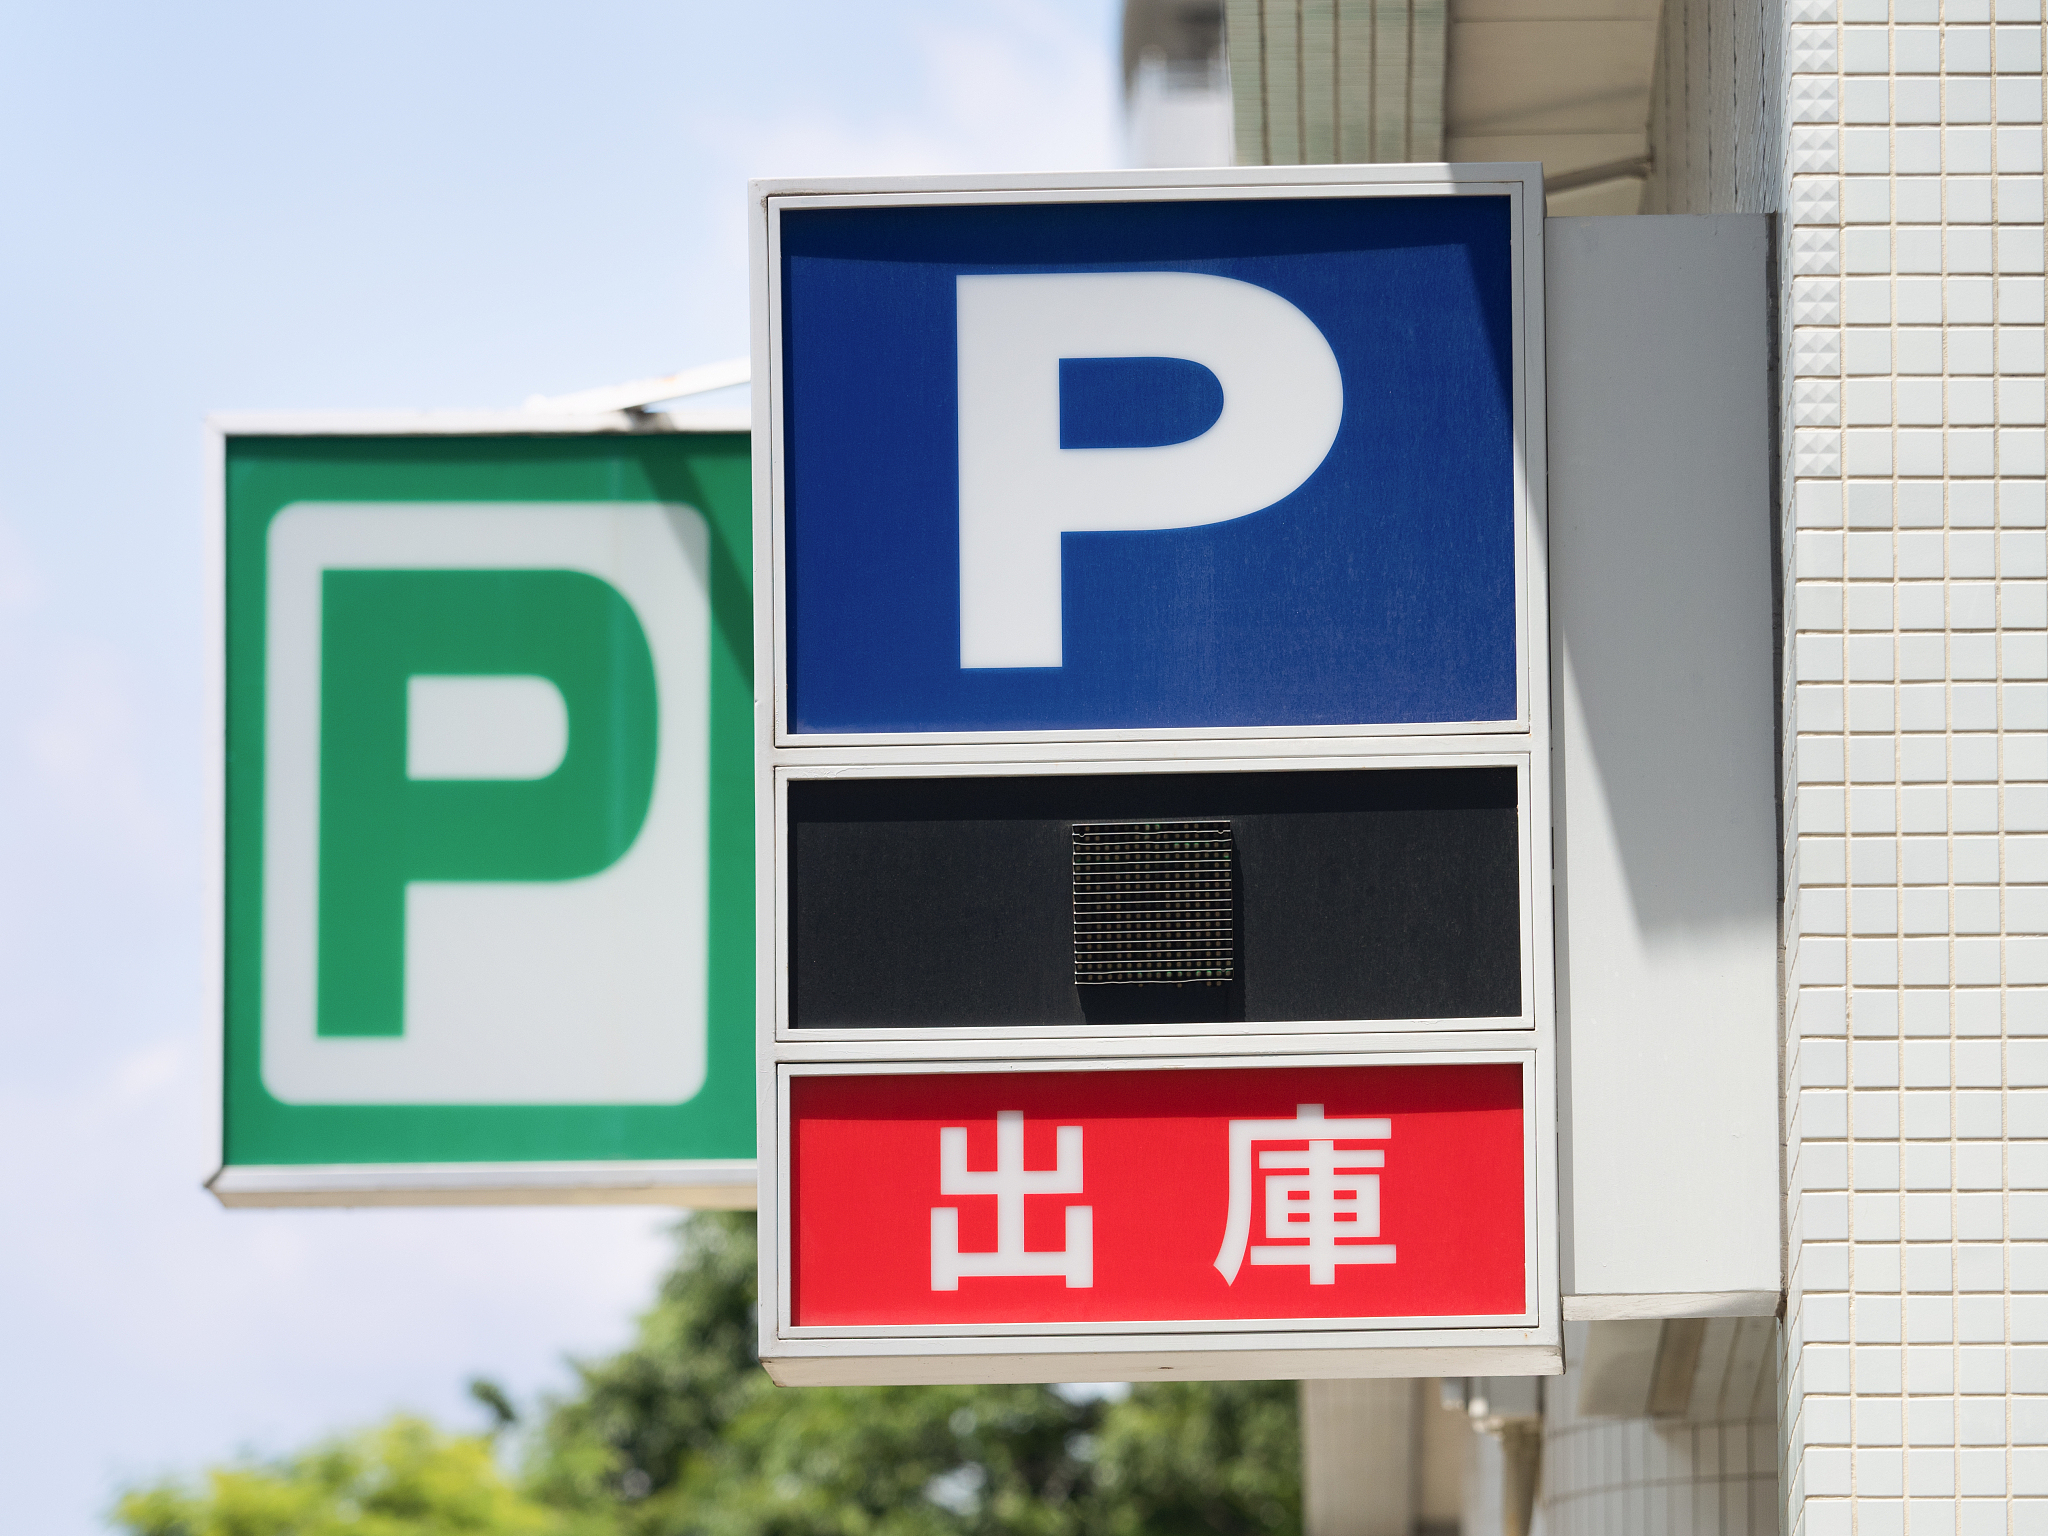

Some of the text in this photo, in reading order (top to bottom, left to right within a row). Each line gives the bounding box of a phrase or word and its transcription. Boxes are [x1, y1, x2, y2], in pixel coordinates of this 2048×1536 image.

[957, 272, 1344, 669] P
[316, 567, 661, 1040] P
[930, 1103, 1397, 1292] 出庫
